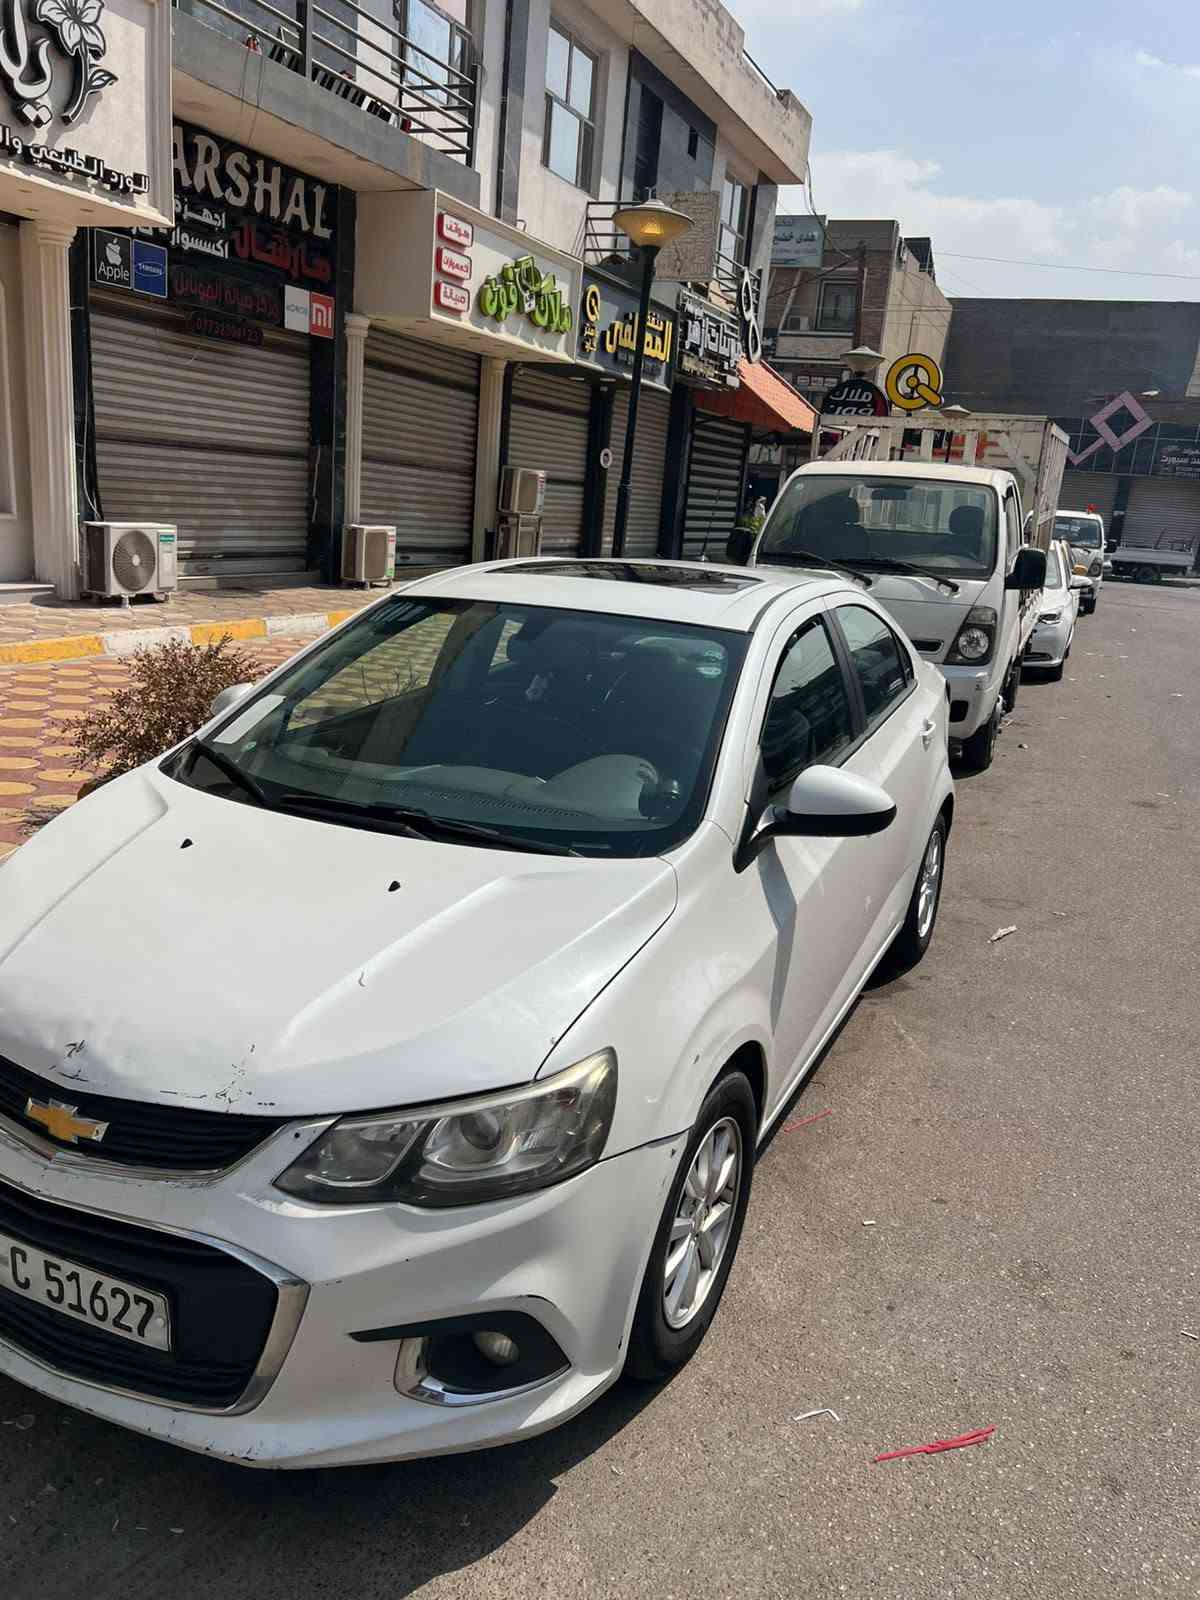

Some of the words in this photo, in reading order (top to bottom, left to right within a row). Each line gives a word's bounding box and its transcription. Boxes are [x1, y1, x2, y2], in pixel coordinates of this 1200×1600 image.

[30, 144, 104, 174] الطبيعي
[108, 171, 150, 194] للورد
[173, 126, 332, 239] ARSHAL
[98, 261, 130, 281] Apple
[10, 1245, 30, 1290] C
[44, 1259, 154, 1337] 51627
